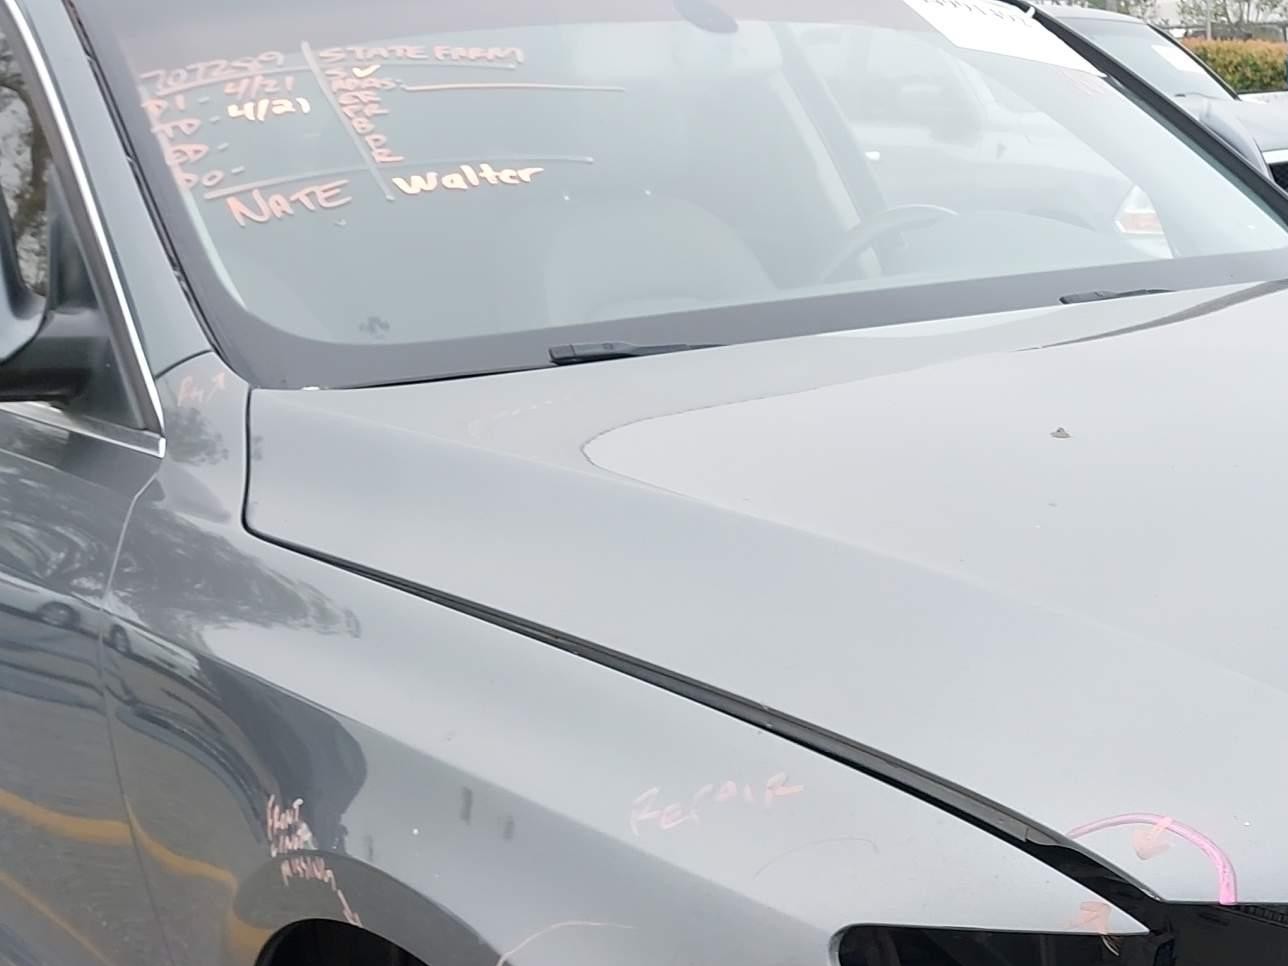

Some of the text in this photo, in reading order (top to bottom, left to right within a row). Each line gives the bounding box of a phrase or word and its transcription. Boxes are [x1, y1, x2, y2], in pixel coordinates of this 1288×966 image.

[319, 46, 525, 64] STATE FARM
[227, 97, 311, 122] 4/21
[393, 163, 544, 195] Walter
